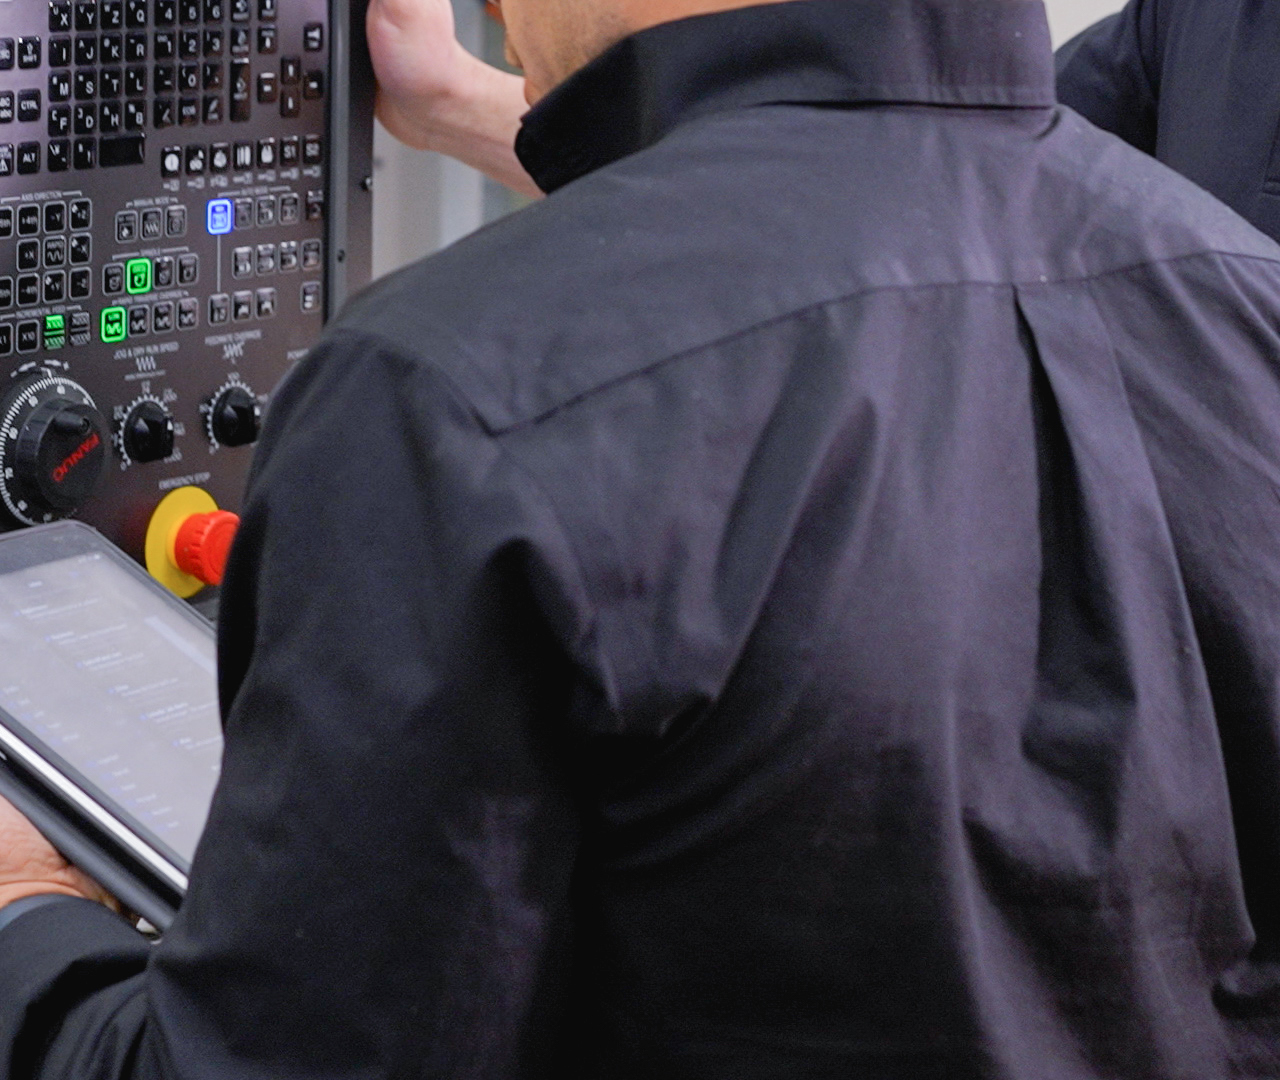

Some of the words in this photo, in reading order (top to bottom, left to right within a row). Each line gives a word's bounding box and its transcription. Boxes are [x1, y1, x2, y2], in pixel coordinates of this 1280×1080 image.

[60, 13, 69, 26] X
[86, 12, 94, 24] Y
[111, 10, 120, 24] Z
[136, 9, 145, 23] Q
[86, 46, 94, 59] J
[111, 45, 119, 58] K
[136, 43, 145, 56] R
[60, 82, 69, 96] M
[85, 80, 94, 94] S
[111, 78, 119, 92] T
[136, 77, 143, 91] L
[20, 100, 38, 110] CTRL
[60, 116, 67, 130] F
[110, 113, 119, 127] H
[22, 152, 36, 163] ALT
